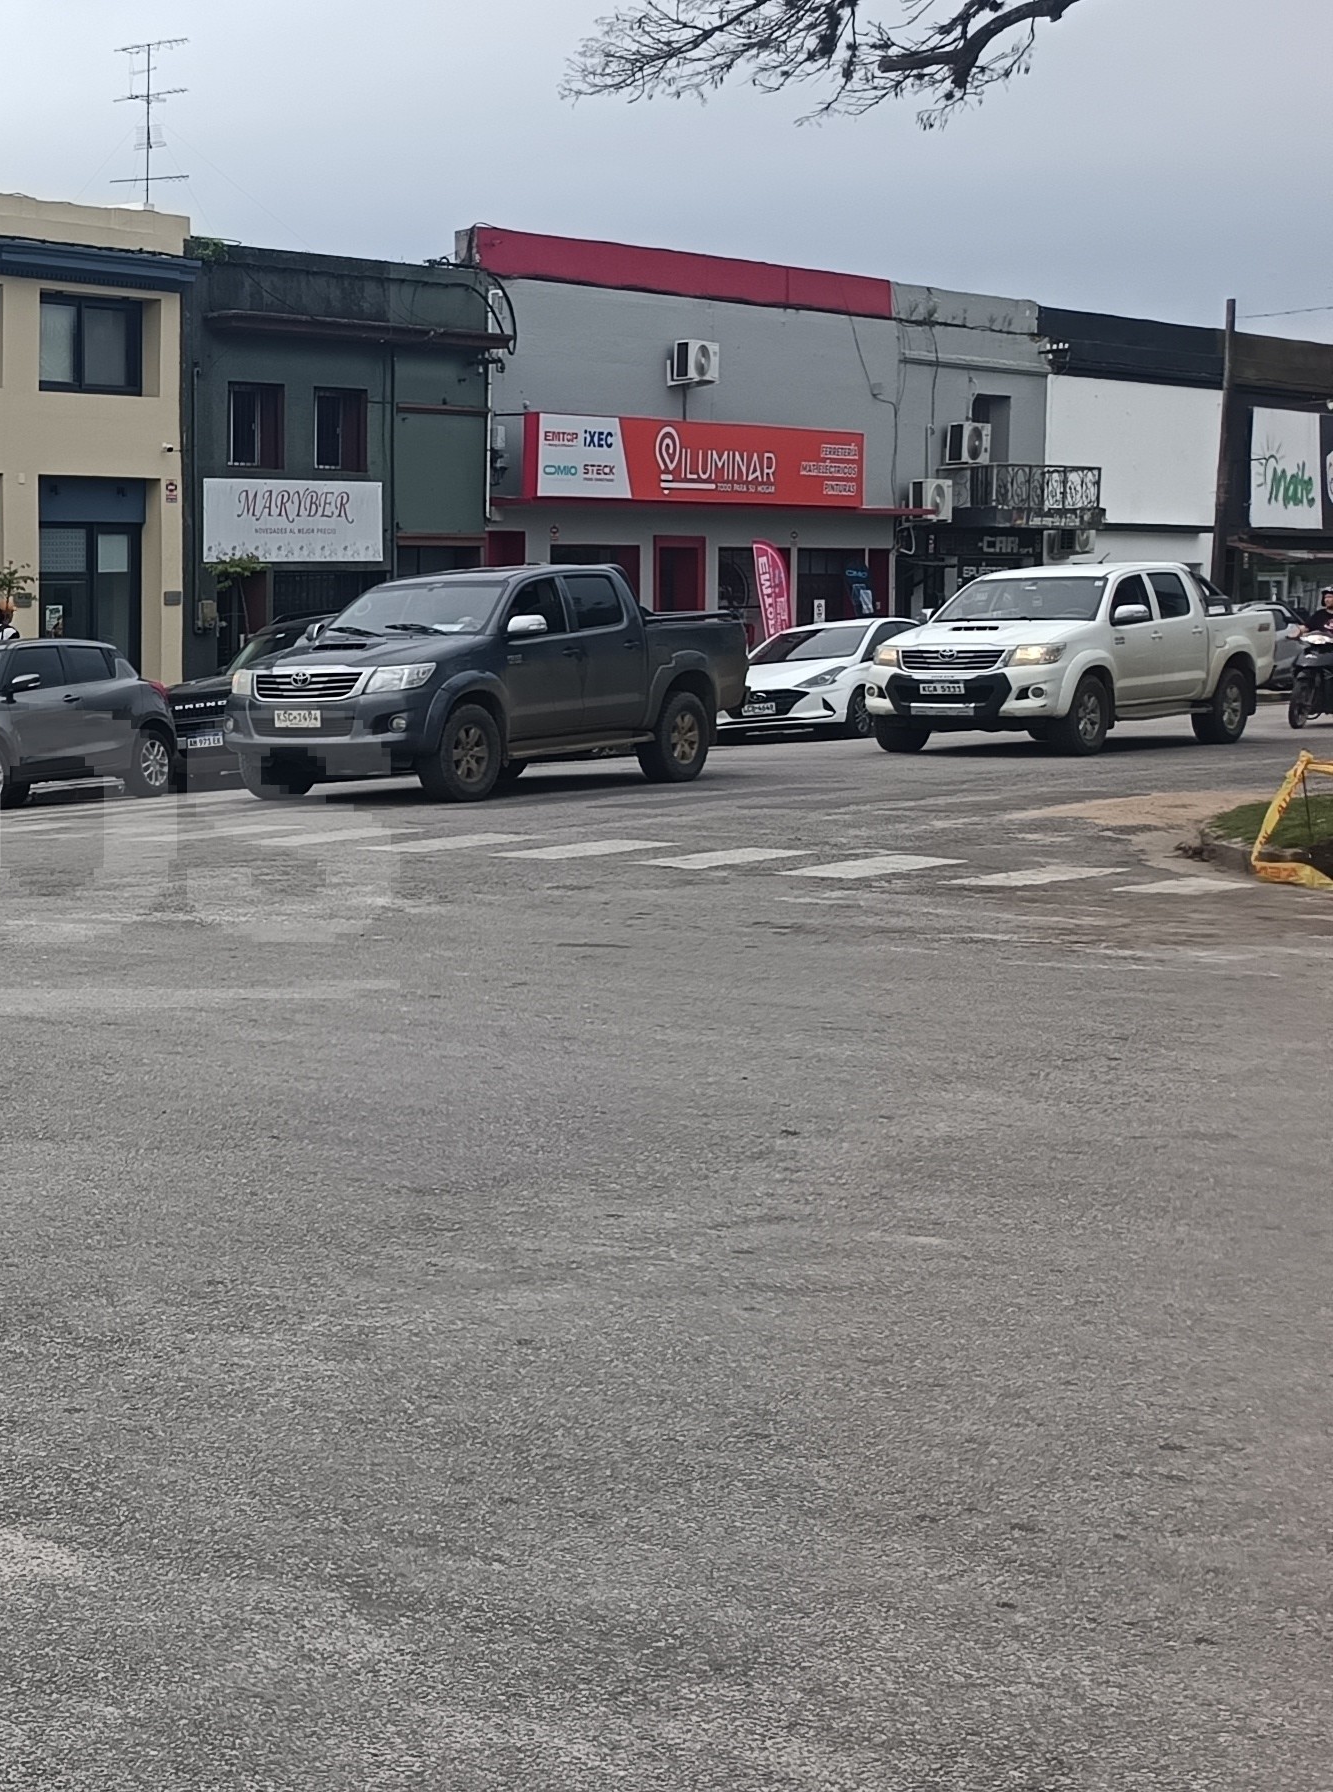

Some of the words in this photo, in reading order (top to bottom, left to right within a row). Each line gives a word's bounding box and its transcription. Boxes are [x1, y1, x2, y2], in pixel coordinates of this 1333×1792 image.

[544, 431, 578, 443] EMTOP
[583, 429, 614, 449] iXEC
[820, 443, 858, 459] FERRETERÍA
[583, 464, 615, 476] STECK
[681, 448, 776, 482] ILUMINAR
[717, 483, 732, 491] TODO
[733, 484, 747, 492] PARA
[823, 481, 856, 496] PINTURAS
[237, 487, 354, 524] MARYBER
[254, 527, 287, 535] NOVEDADES
[289, 527, 296, 535] AL
[297, 527, 315, 535] MEJOR
[316, 527, 337, 535] PRECIO
